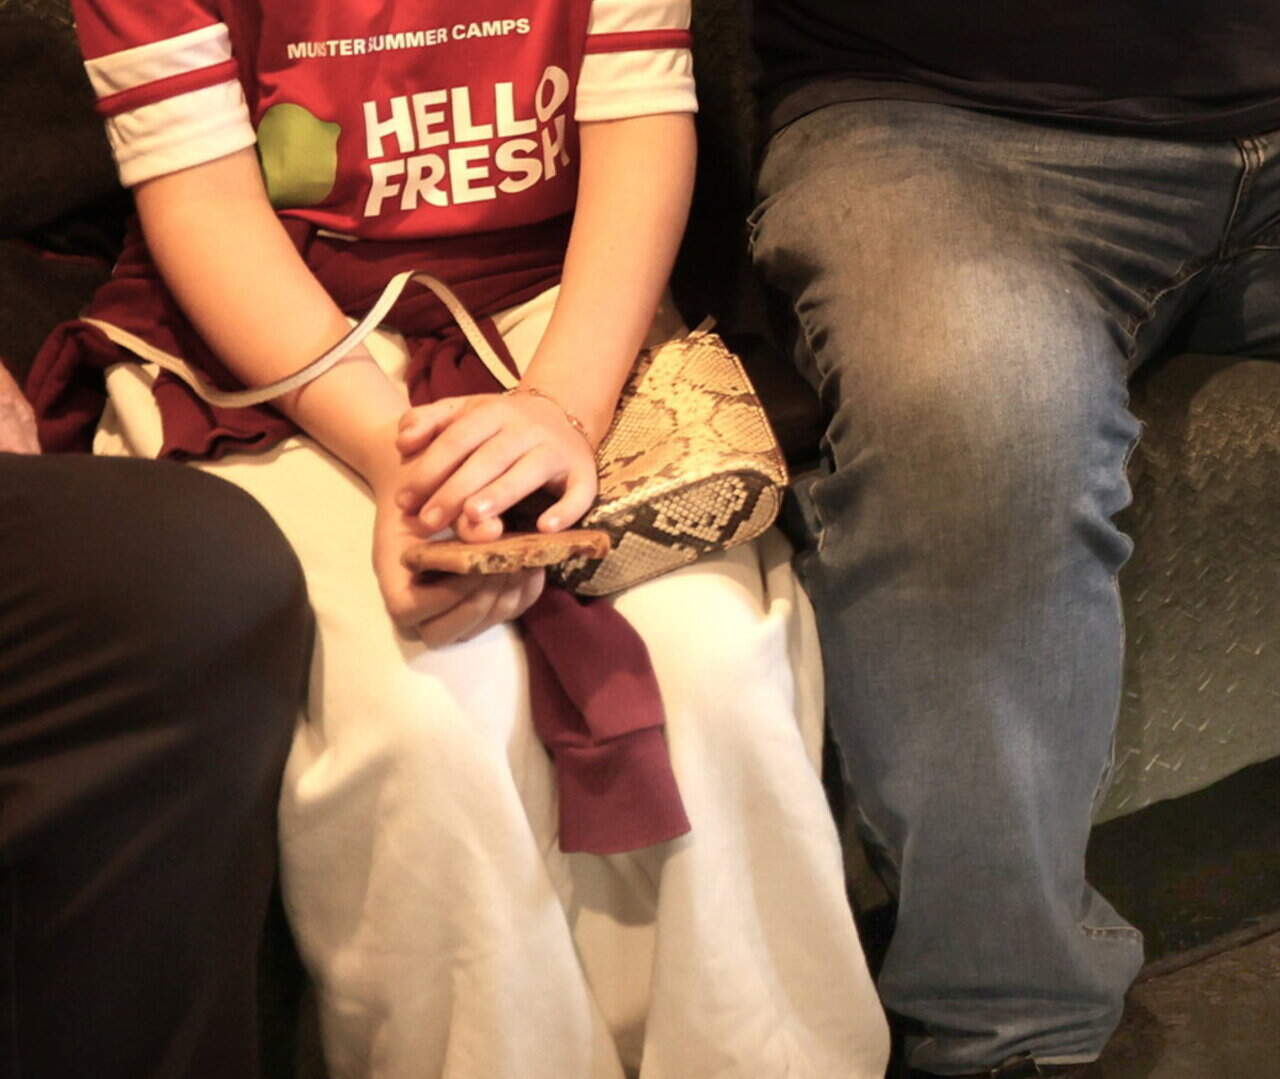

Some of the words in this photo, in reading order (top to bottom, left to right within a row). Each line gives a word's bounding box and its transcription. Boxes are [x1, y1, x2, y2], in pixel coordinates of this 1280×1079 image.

[451, 17, 531, 41] CAMPS
[362, 65, 570, 160] HELLO
[363, 113, 571, 218] FRESH
